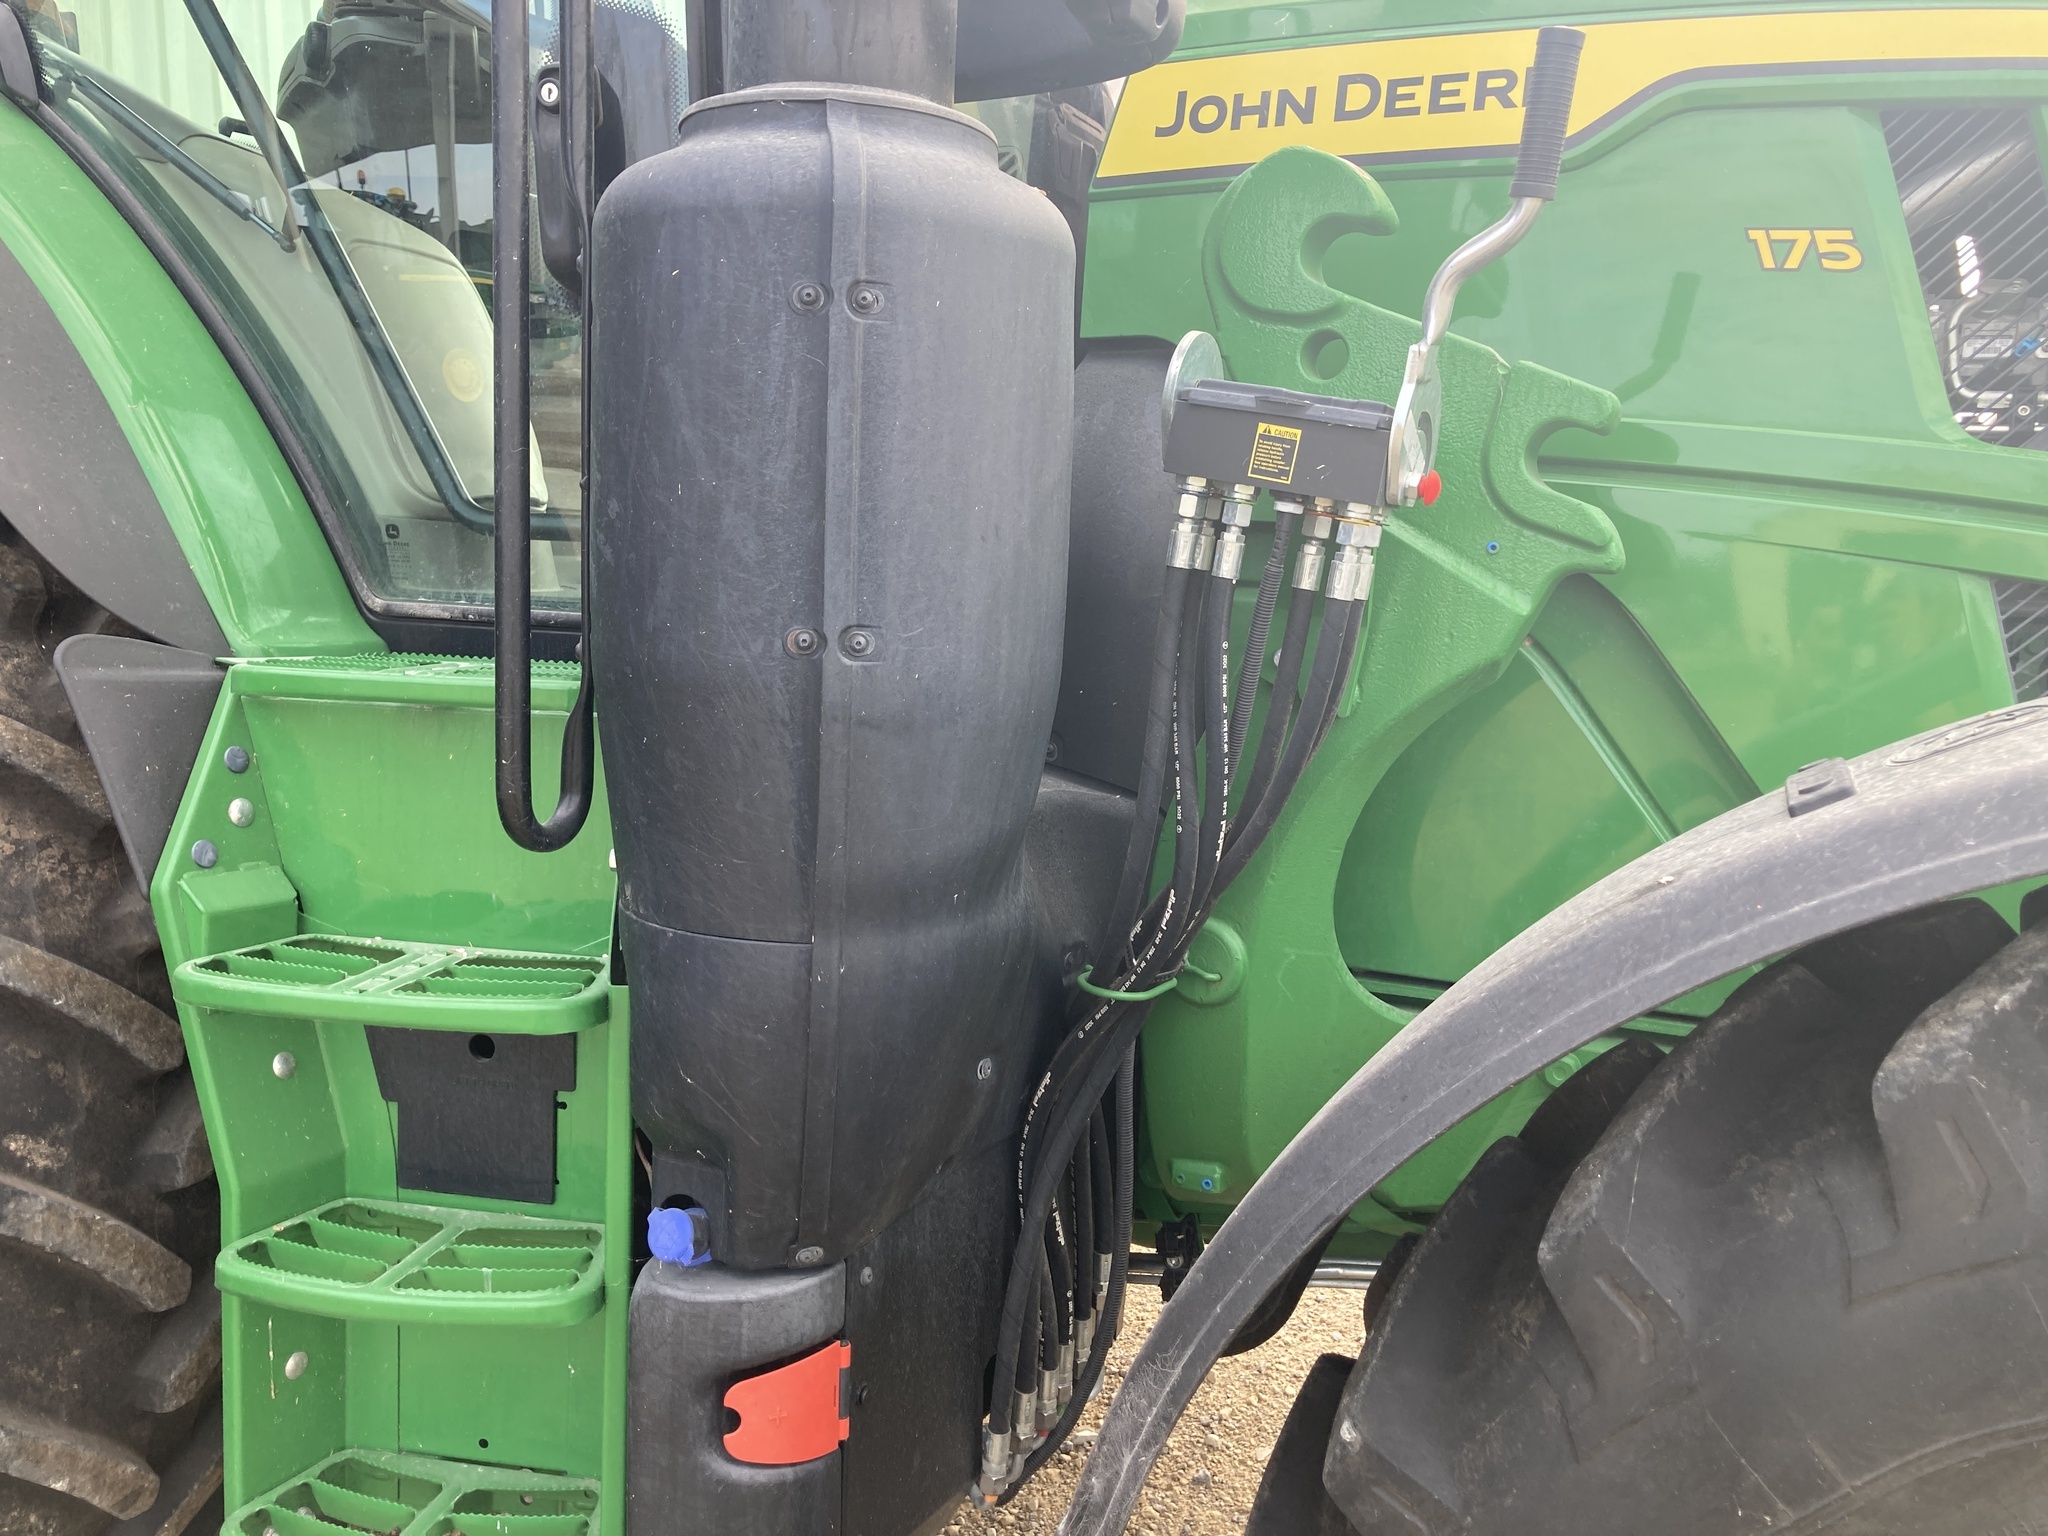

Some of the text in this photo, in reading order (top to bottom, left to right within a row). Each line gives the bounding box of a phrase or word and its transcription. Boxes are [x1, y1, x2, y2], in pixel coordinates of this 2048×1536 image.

[1155, 86, 1317, 137] JOHN
[1744, 226, 1865, 273] 175
[1274, 429, 1298, 438] CAUTION
